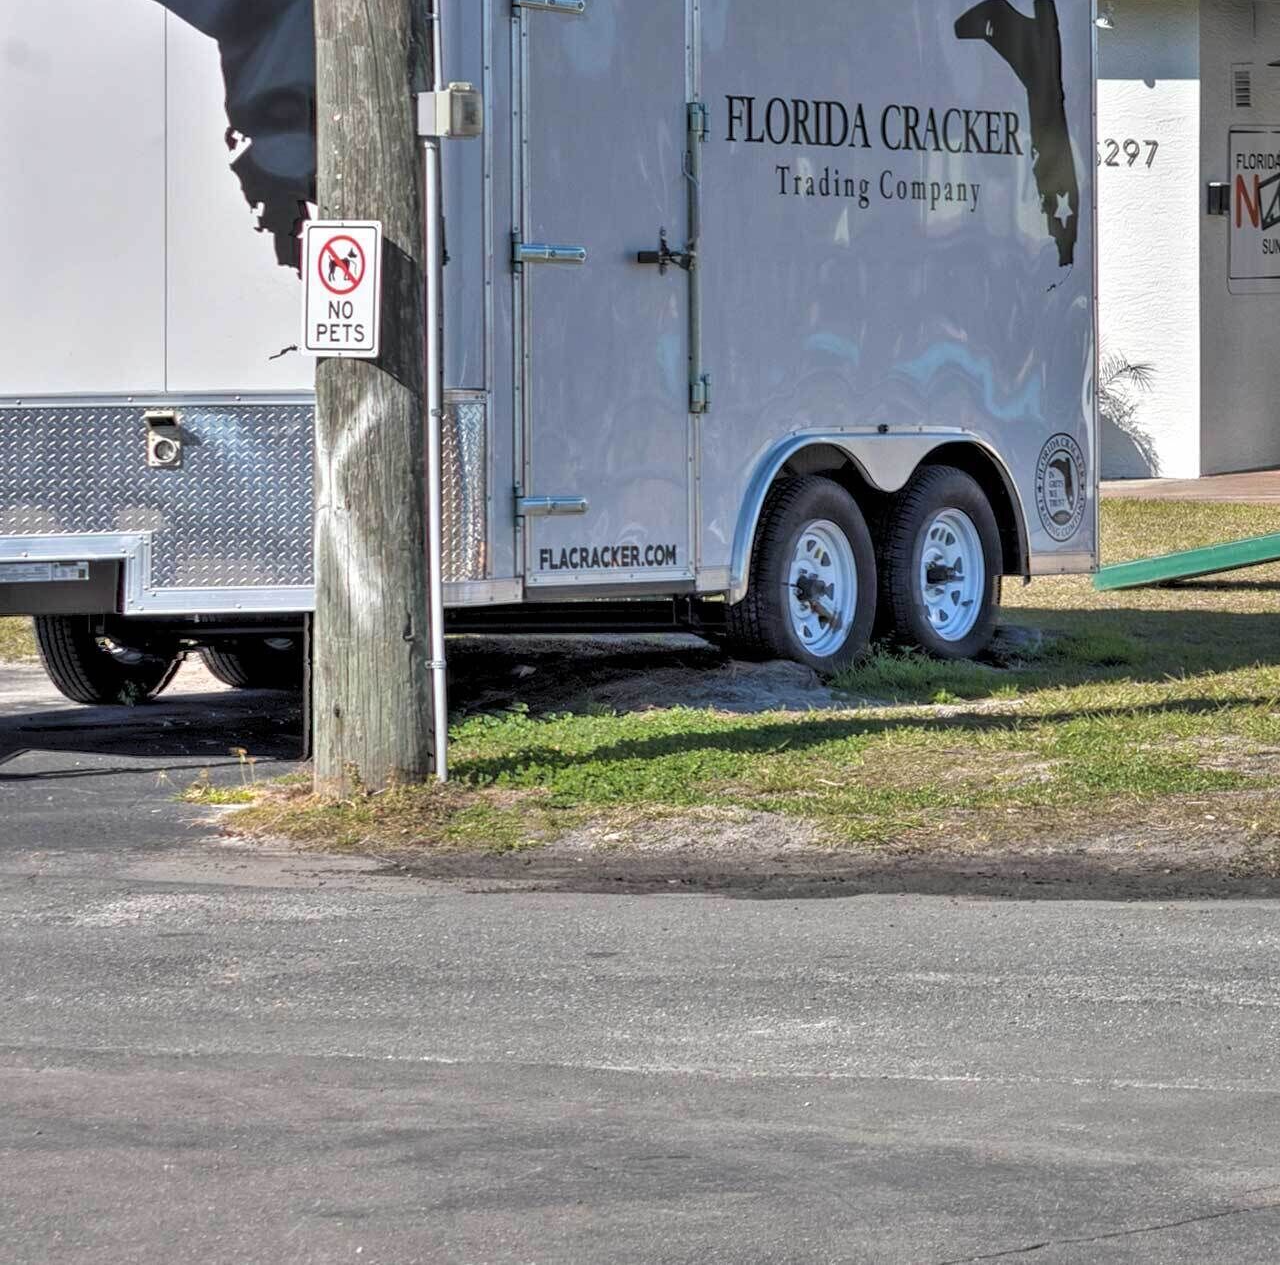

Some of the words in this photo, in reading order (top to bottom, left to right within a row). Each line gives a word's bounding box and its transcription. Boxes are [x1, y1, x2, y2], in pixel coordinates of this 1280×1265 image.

[725, 94, 872, 149] FLORIDA
[880, 103, 1024, 156] CRACKER
[775, 165, 870, 210] Trading
[879, 169, 981, 213] Company
[328, 300, 354, 320] NO
[316, 323, 365, 343] PETS
[539, 543, 678, 571] FLACRACKER.COM
